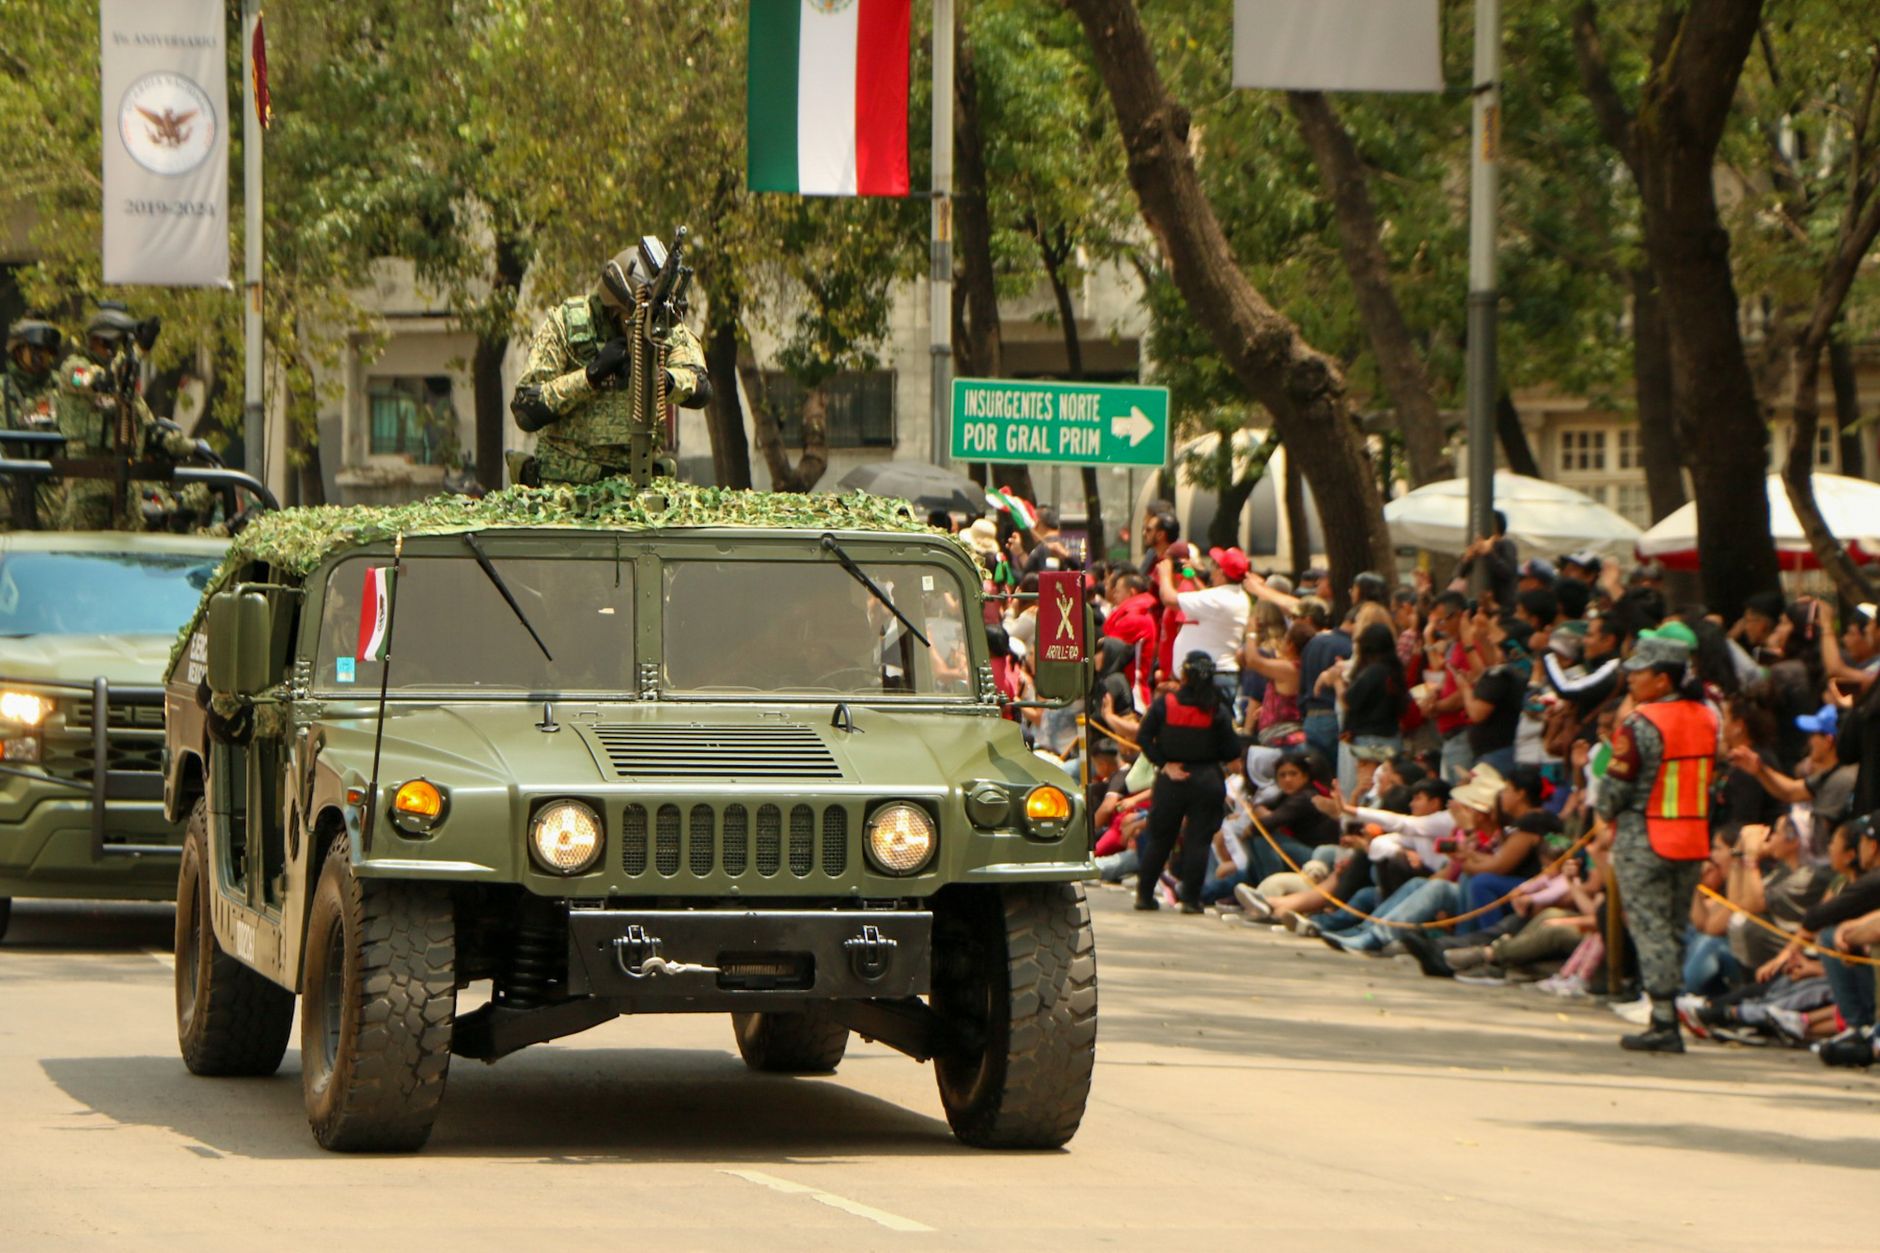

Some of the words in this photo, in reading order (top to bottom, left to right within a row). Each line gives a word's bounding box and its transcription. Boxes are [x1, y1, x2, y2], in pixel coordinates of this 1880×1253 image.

[964, 388, 1054, 421] INSURGENTES
[1058, 393, 1102, 423] NORTE
[963, 422, 998, 453] POR
[1006, 423, 1052, 454] GRAL
[1058, 426, 1102, 456] PRIM
